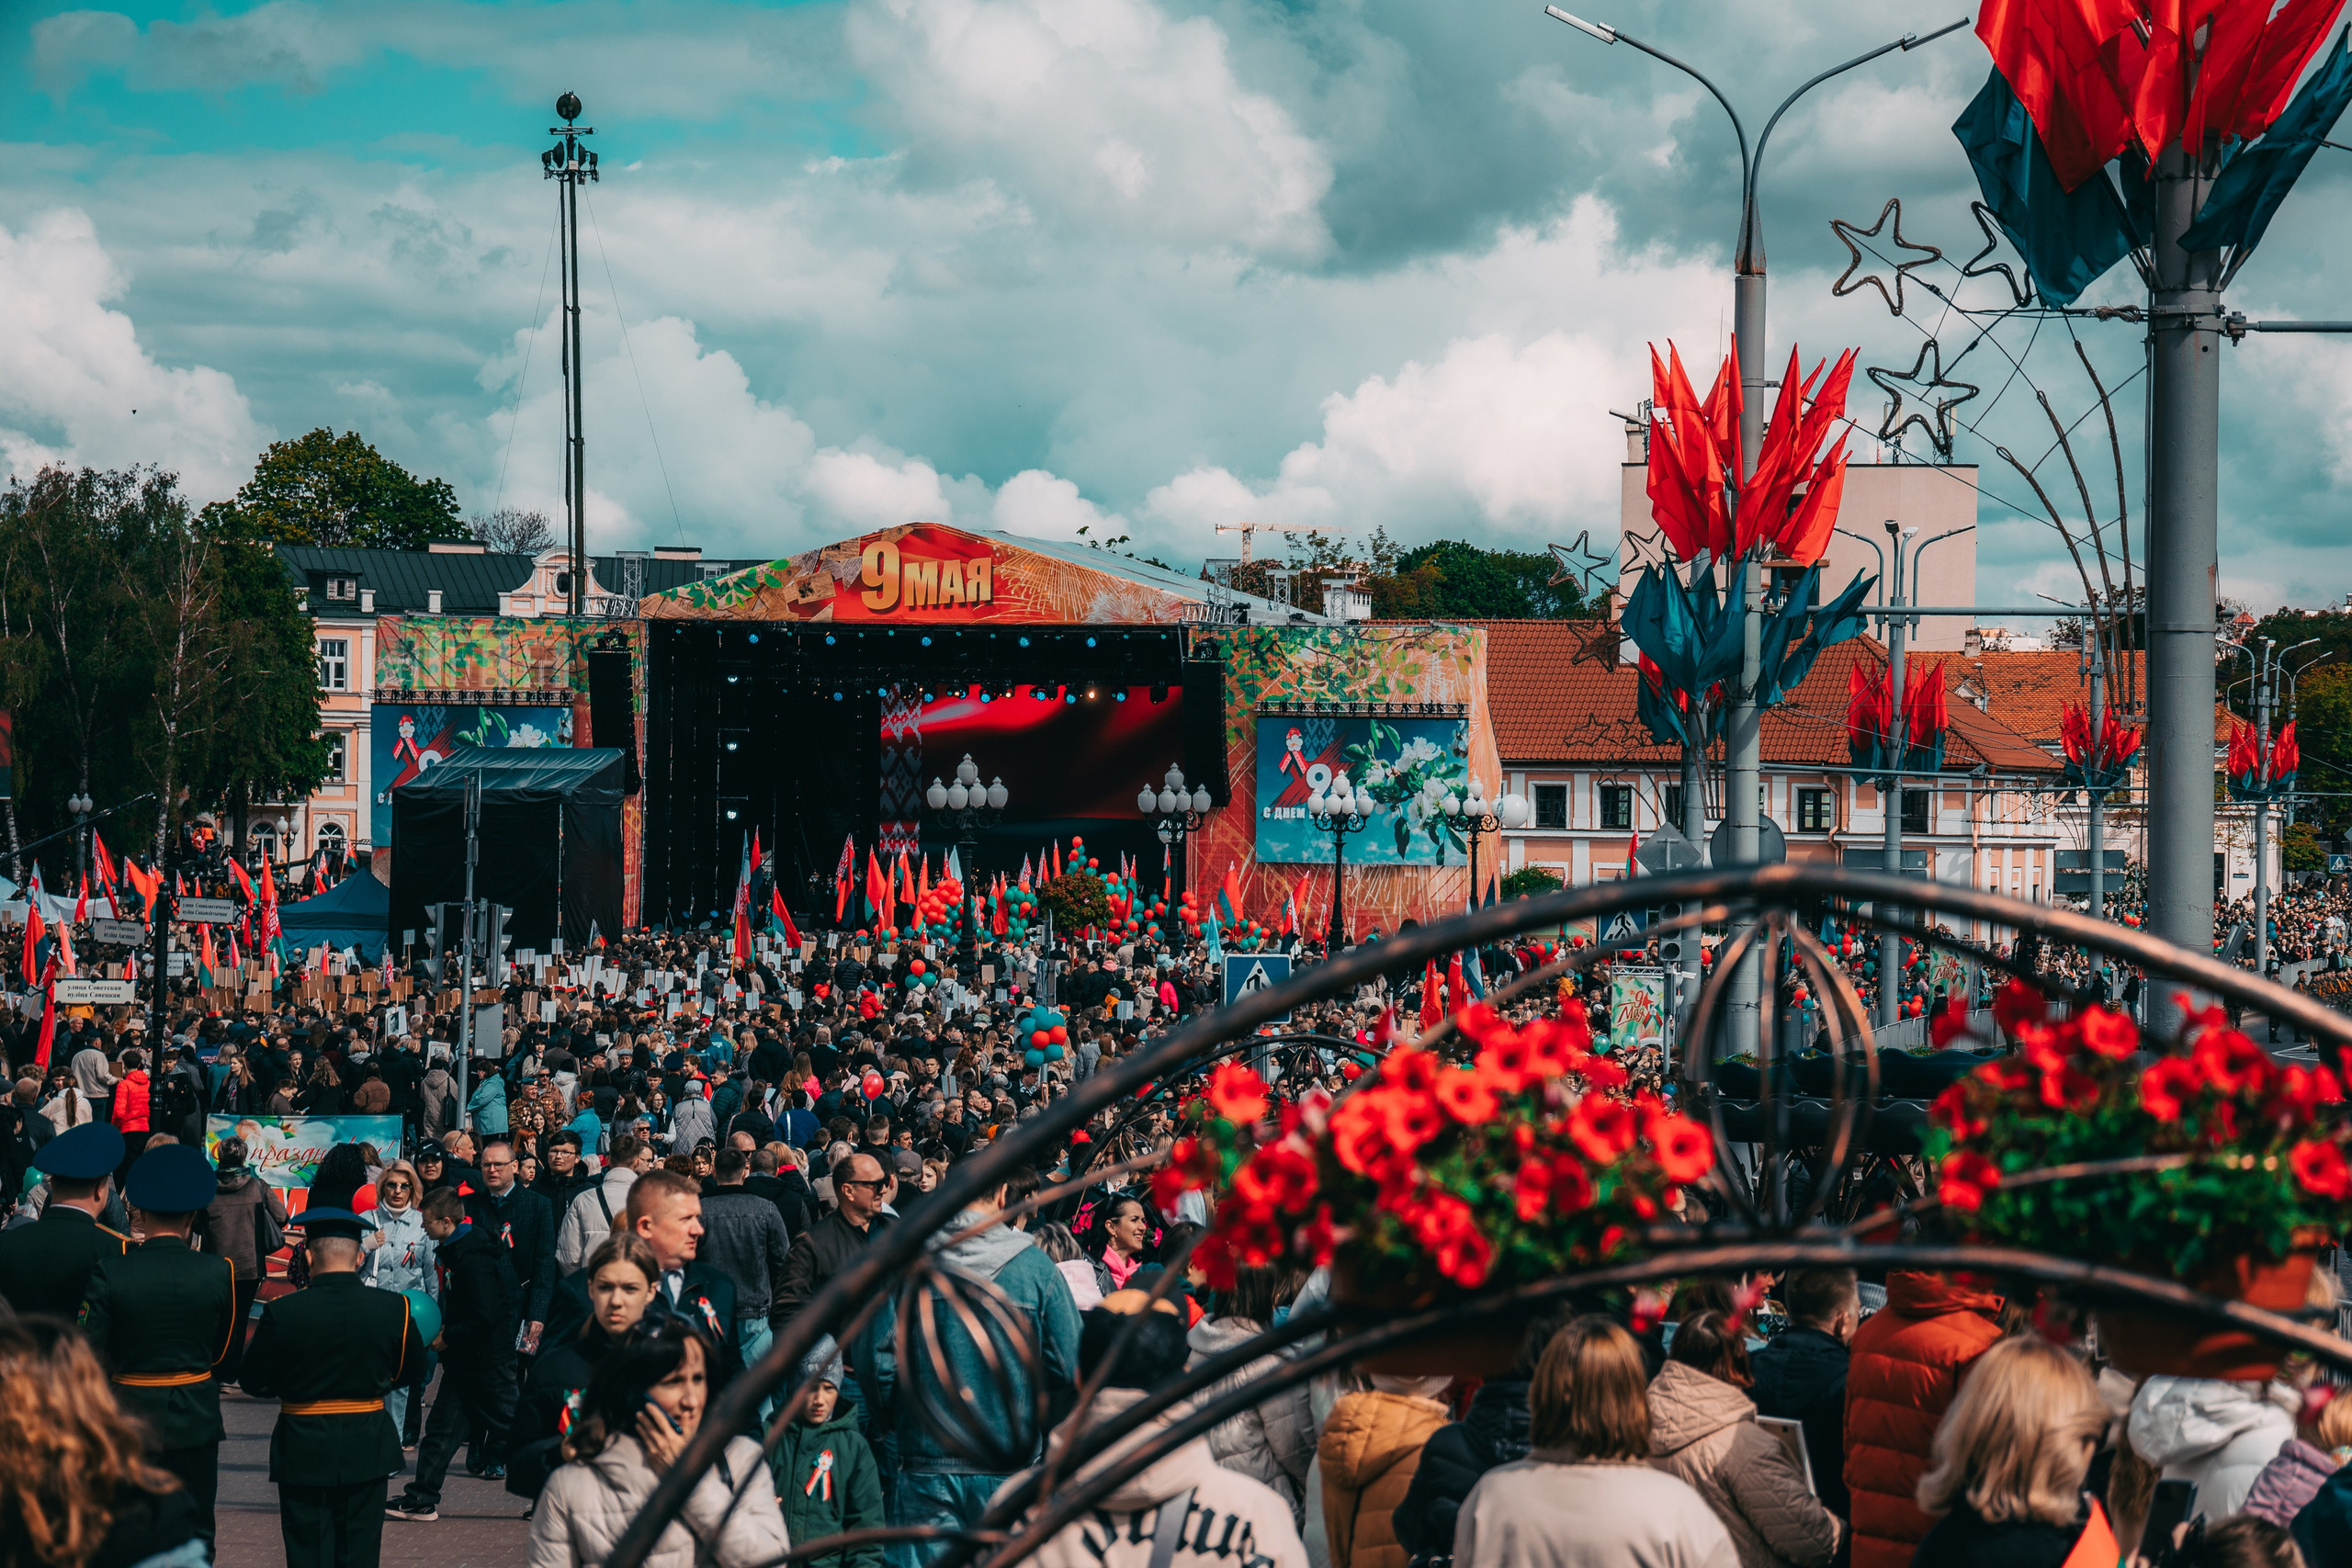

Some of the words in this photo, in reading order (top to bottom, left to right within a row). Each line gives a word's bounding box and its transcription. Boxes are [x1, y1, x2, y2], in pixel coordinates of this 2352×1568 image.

[861, 541, 900, 610] 9
[904, 557, 992, 606] МАЯ
[1262, 807, 1271, 818] С
[1273, 807, 1306, 820] ДНЕМ
[1634, 990, 1645, 1008] 9
[1617, 1002, 1645, 1025] Мая
